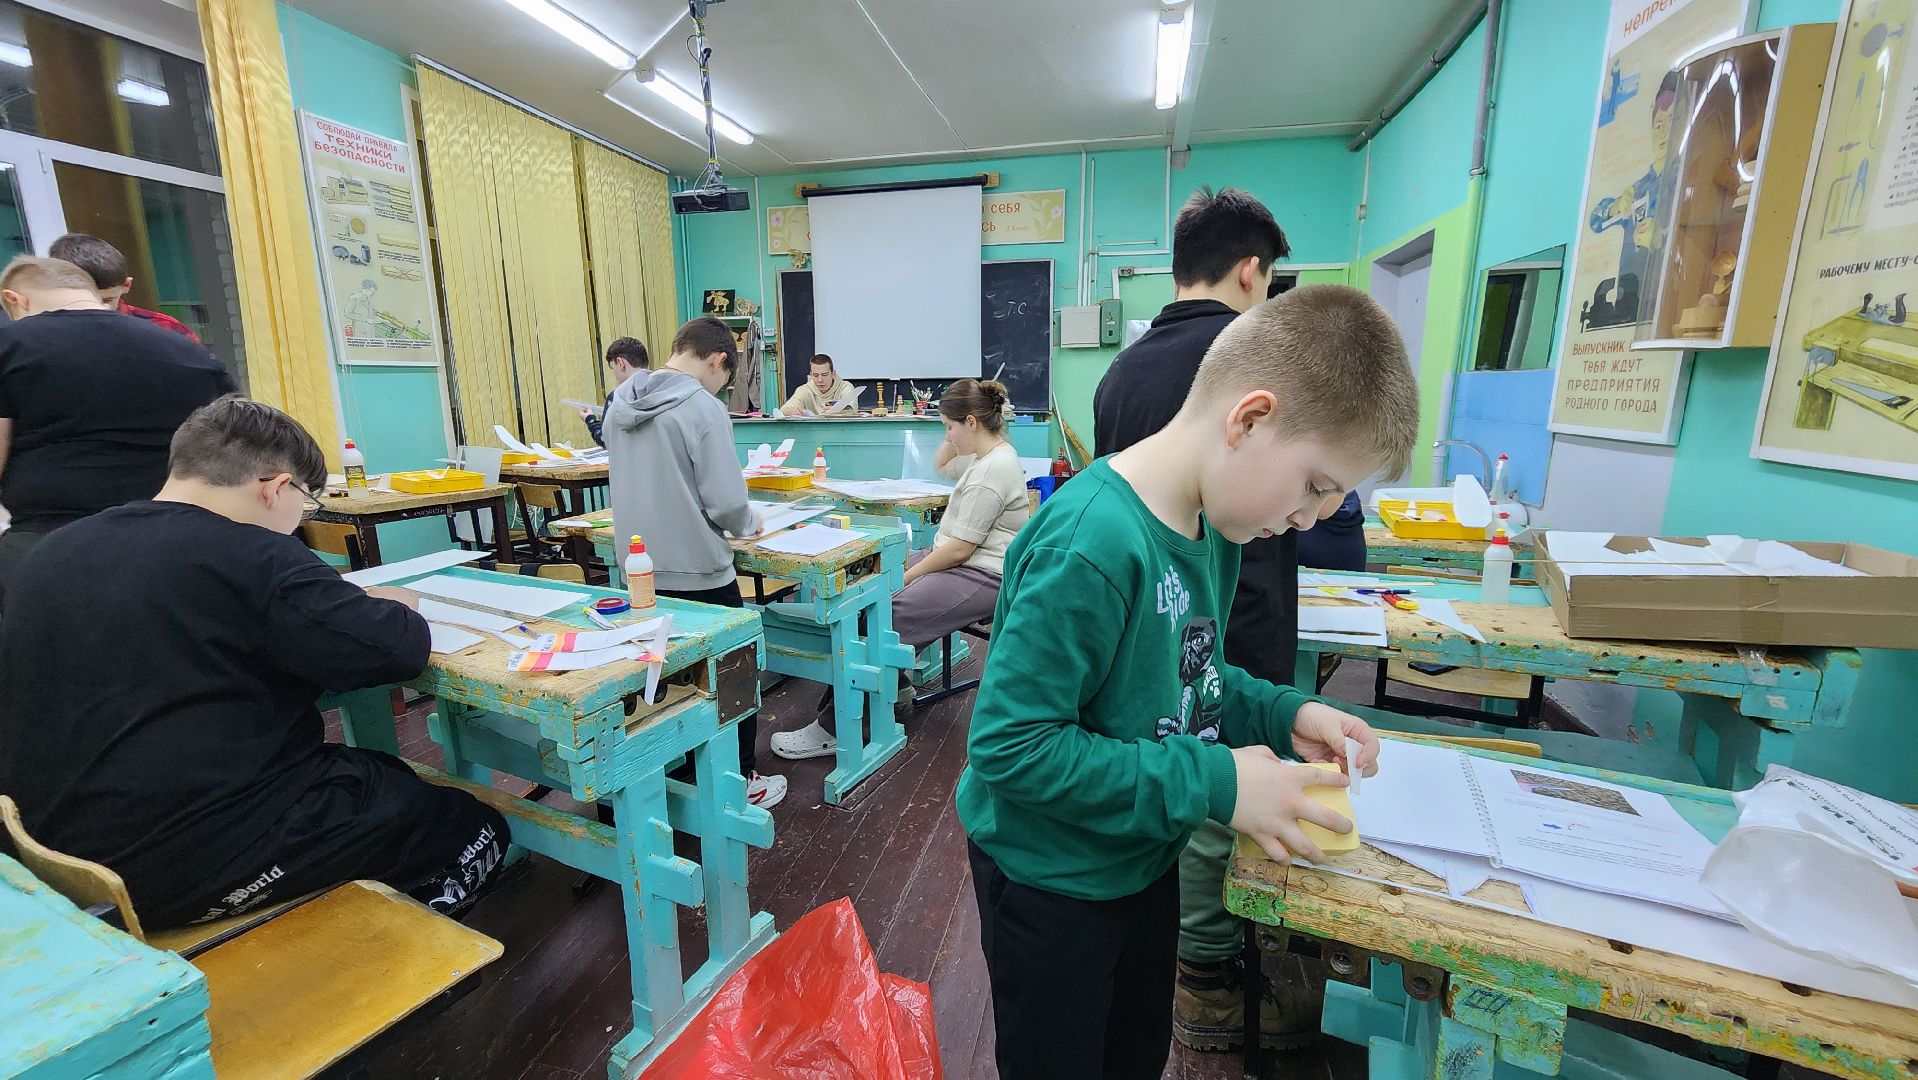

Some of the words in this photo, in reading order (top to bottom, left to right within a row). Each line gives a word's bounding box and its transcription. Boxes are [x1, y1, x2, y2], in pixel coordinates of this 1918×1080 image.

[364, 136, 398, 152] ПРАВИЛА
[1819, 261, 1871, 279] РАБОЧЕМУ
[1572, 340, 1626, 356] ВЫПУСКНИК
[1610, 358, 1643, 373] ЖДУТ
[1565, 396, 1609, 411] РОДНОГО
[1614, 398, 1657, 413] ГОРОДА
